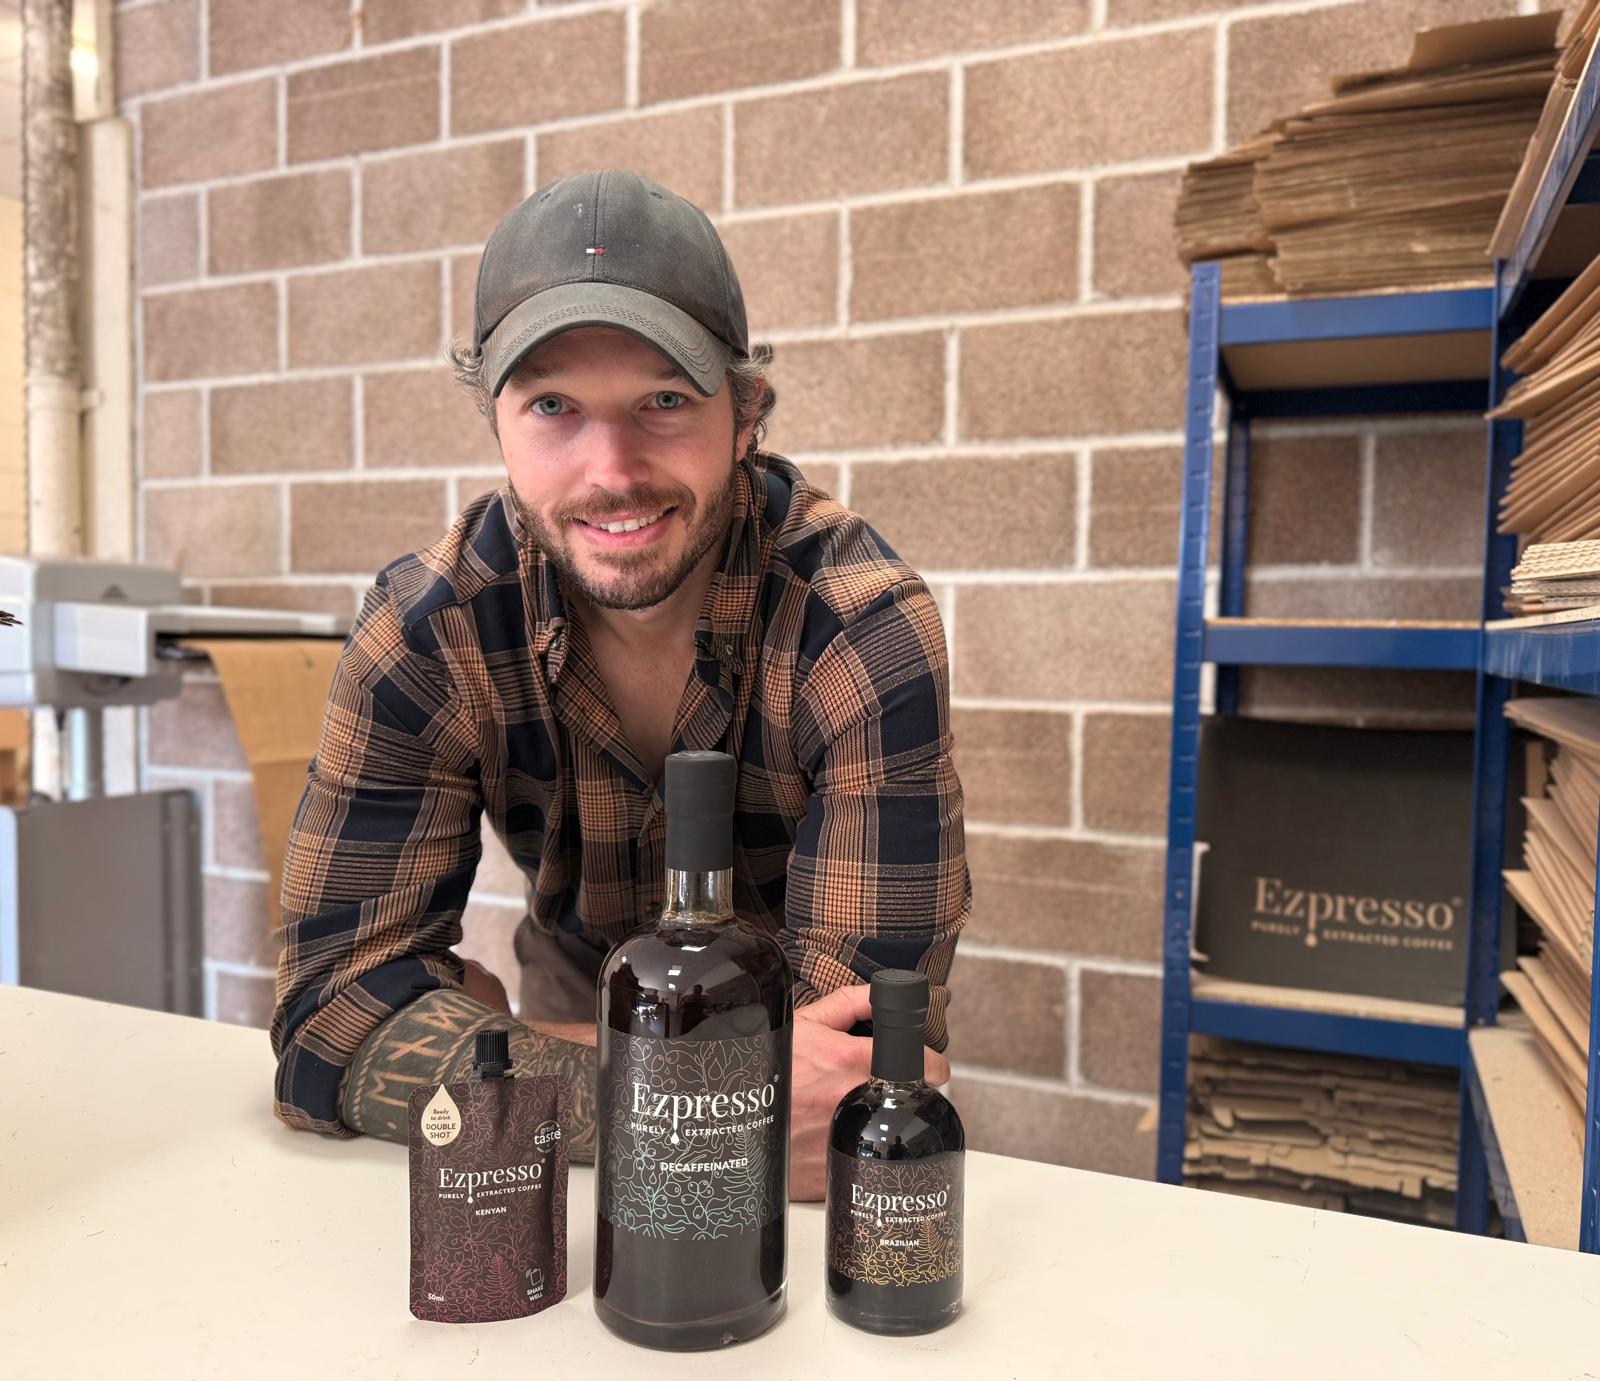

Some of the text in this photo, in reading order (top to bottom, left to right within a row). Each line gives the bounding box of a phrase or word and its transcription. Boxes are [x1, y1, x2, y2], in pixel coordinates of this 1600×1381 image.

[1255, 876, 1454, 934] Ezpresso
[1251, 919, 1453, 951] PURELY EXTRACTED COFFEE
[631, 1082, 775, 1137] Ezpresso
[631, 1114, 775, 1137] PURELY EXTRACTED COFFEE
[430, 1131, 452, 1139] SHOT
[534, 1130, 562, 1145] taste
[660, 1157, 749, 1172] DECAFFEINATED
[438, 1163, 543, 1199] Ezpresso
[476, 1187, 516, 1198] EXTRACTED
[517, 1183, 543, 1192] COFFEE
[851, 1183, 948, 1221] Ezpresso
[475, 1206, 507, 1216] KENYAN
[850, 1209, 874, 1220] PURELY
[926, 1210, 948, 1222] COFFEE
[427, 1293, 445, 1302] 50ml
[526, 1285, 544, 1296] SHAKE
[529, 1292, 543, 1302] WELL
